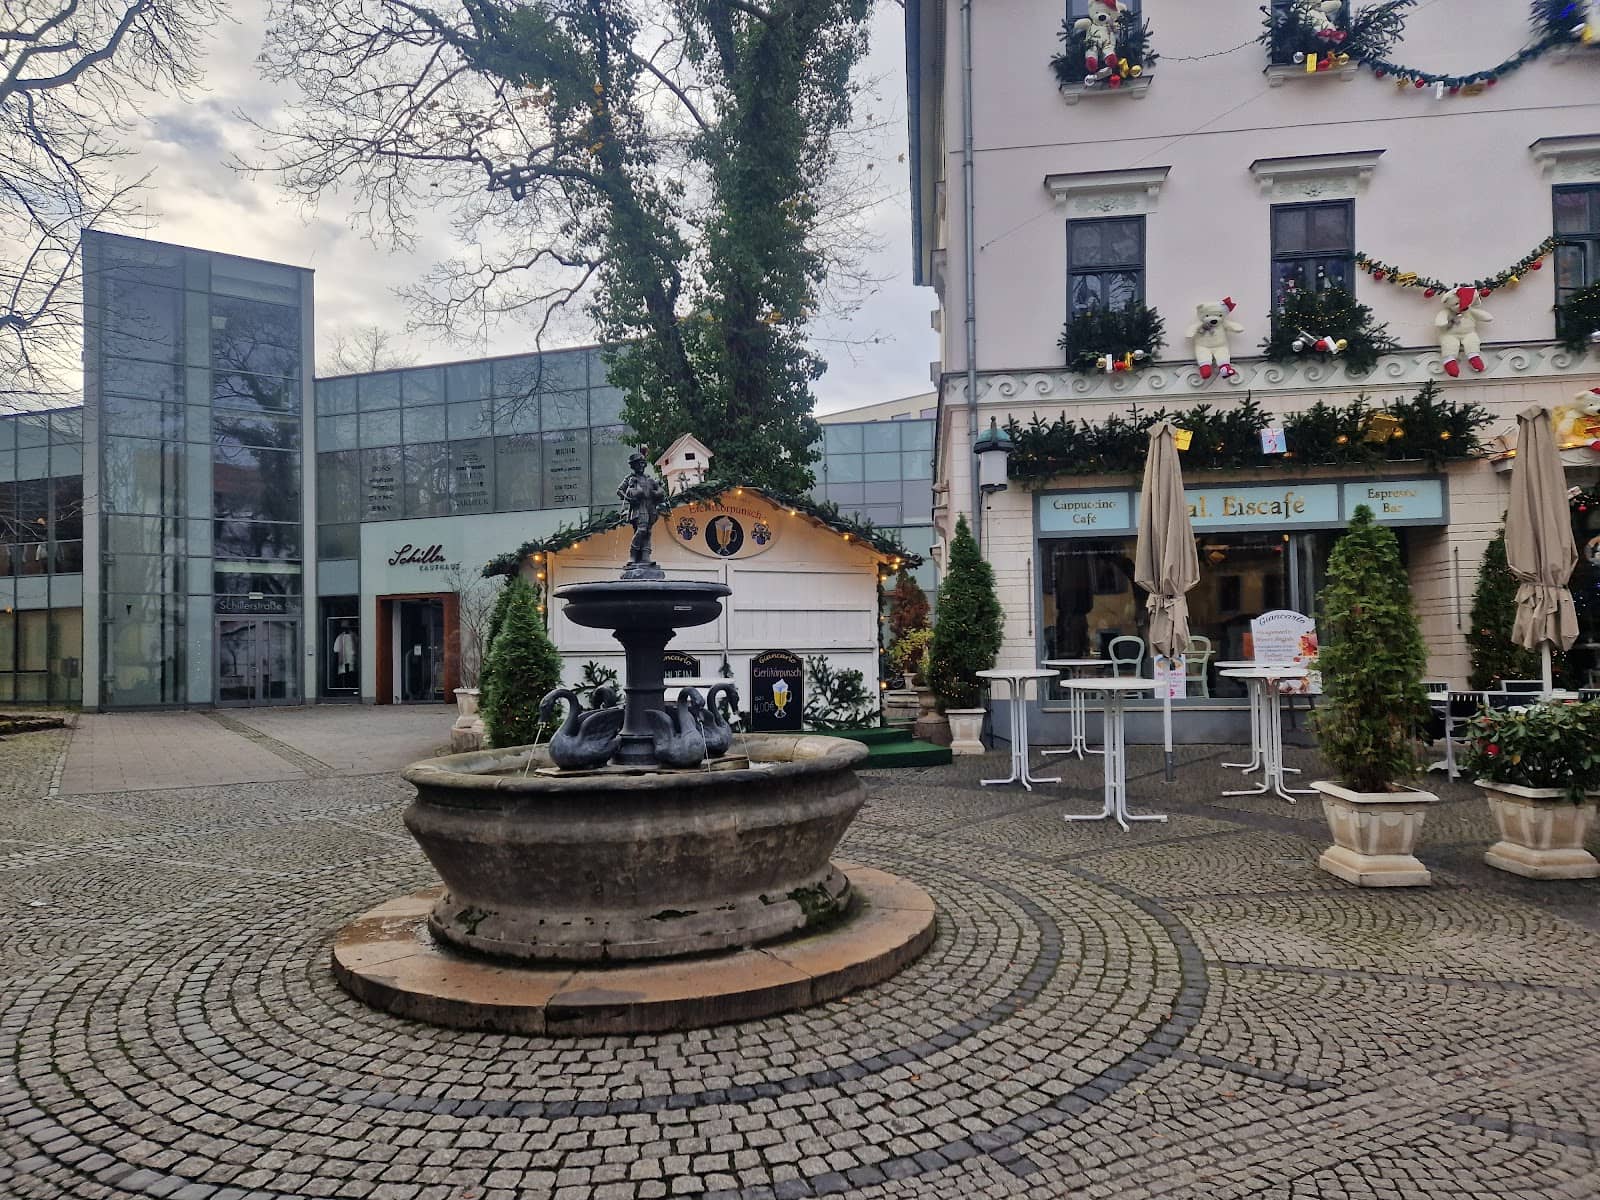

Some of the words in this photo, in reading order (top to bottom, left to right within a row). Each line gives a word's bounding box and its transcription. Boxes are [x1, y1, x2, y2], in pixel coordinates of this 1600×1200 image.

[1367, 488, 1416, 501] Espresso
[1188, 495, 1213, 518] al.
[1222, 491, 1305, 520] Eiscafé
[1383, 502, 1403, 513] Bar
[1072, 512, 1097, 525] Café
[388, 544, 446, 566] Schiller
[219, 600, 282, 610] Schillerstraße
[1259, 614, 1306, 626] Giancarlo
[663, 655, 692, 666] ncarlo
[759, 653, 797, 664] Giancarlo
